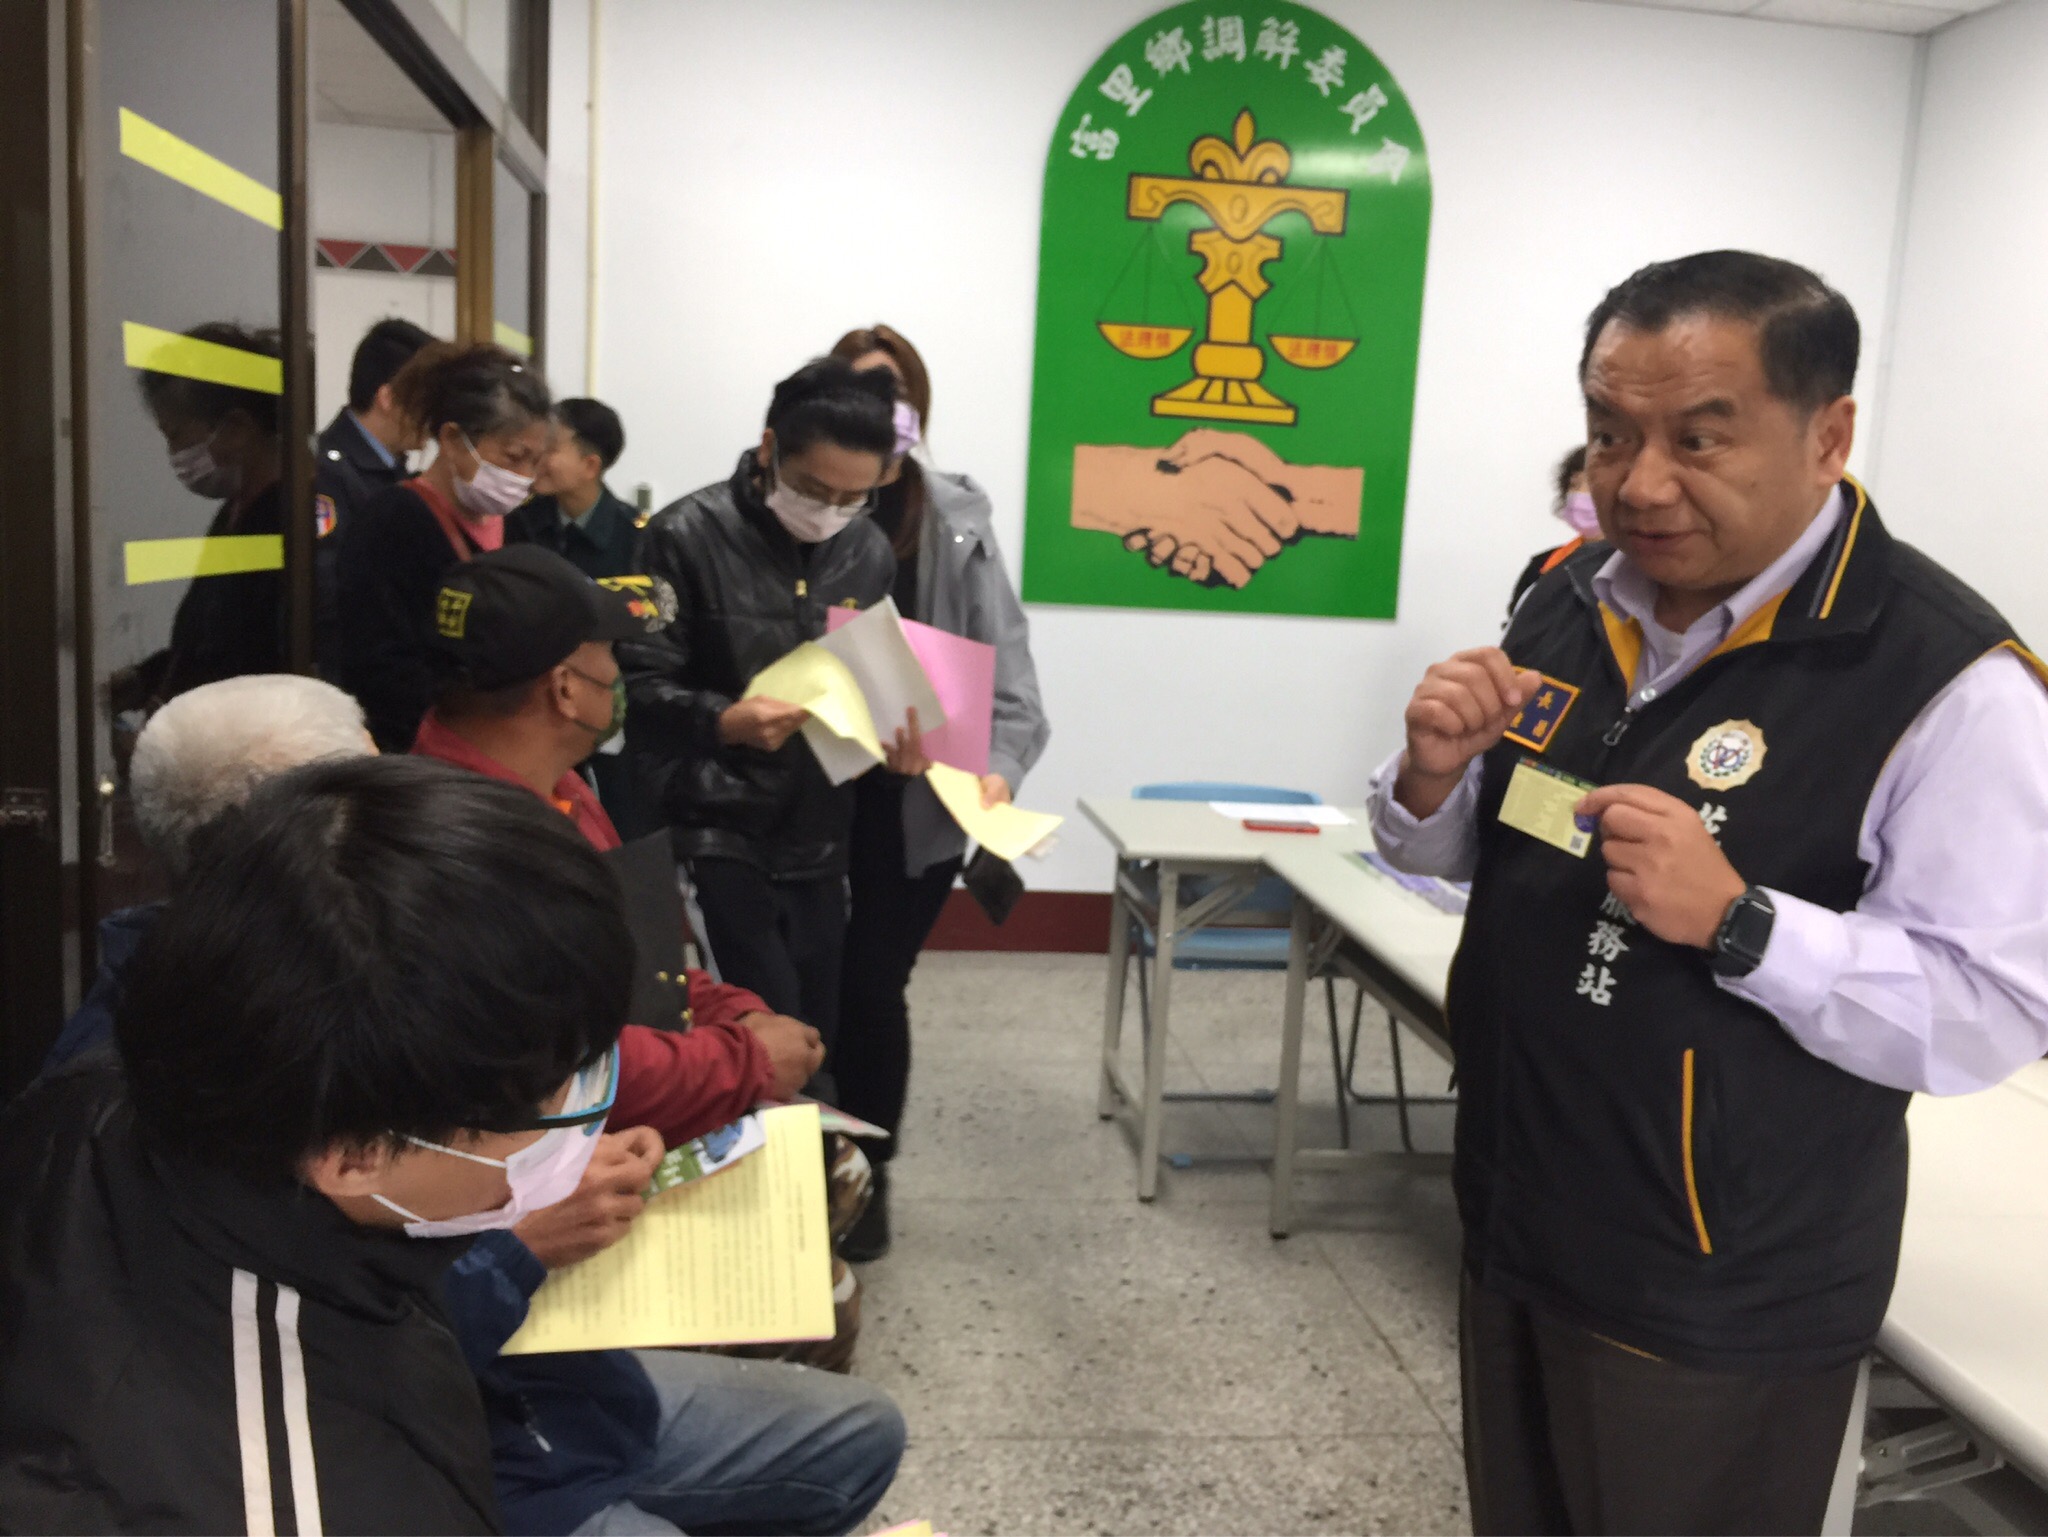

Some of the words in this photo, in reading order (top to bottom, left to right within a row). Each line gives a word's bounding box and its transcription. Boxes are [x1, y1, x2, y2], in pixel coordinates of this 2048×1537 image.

[1069, 14, 1411, 185] 富里鄉調解委員會
